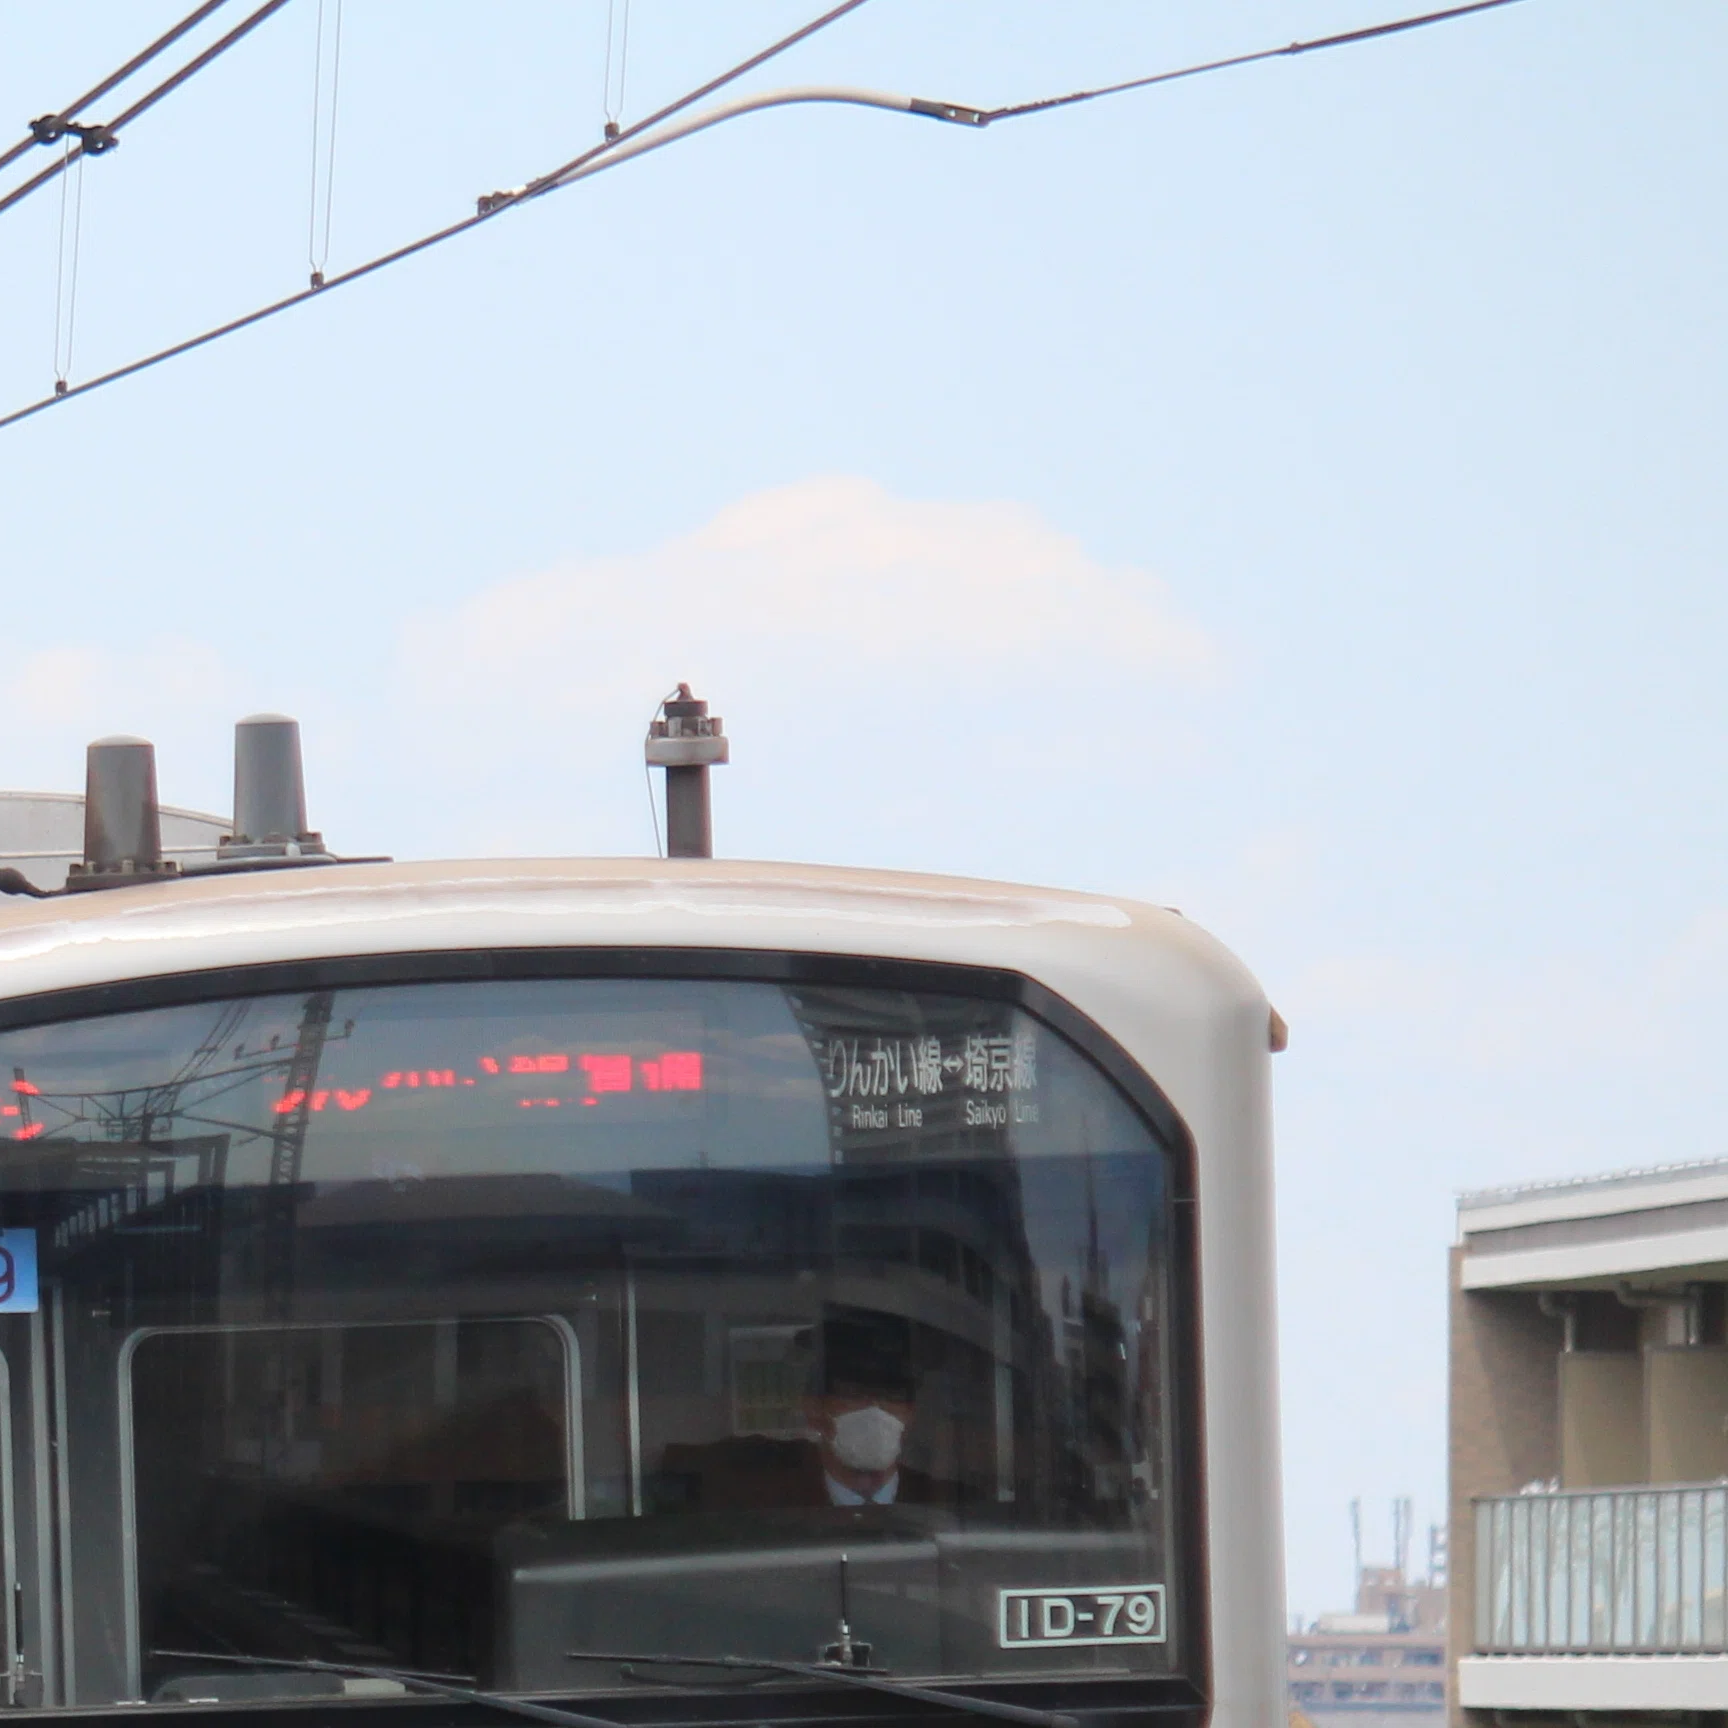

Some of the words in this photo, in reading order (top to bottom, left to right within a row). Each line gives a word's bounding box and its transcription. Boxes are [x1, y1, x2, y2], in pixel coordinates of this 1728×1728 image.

[828, 1034, 943, 1097] りんかい線
[964, 1033, 1037, 1093] 埼京線
[852, 1103, 888, 1129] Rinkai
[898, 1102, 922, 1128] Line
[965, 1100, 1007, 1129] Saikyo
[1015, 1102, 1039, 1123] Line
